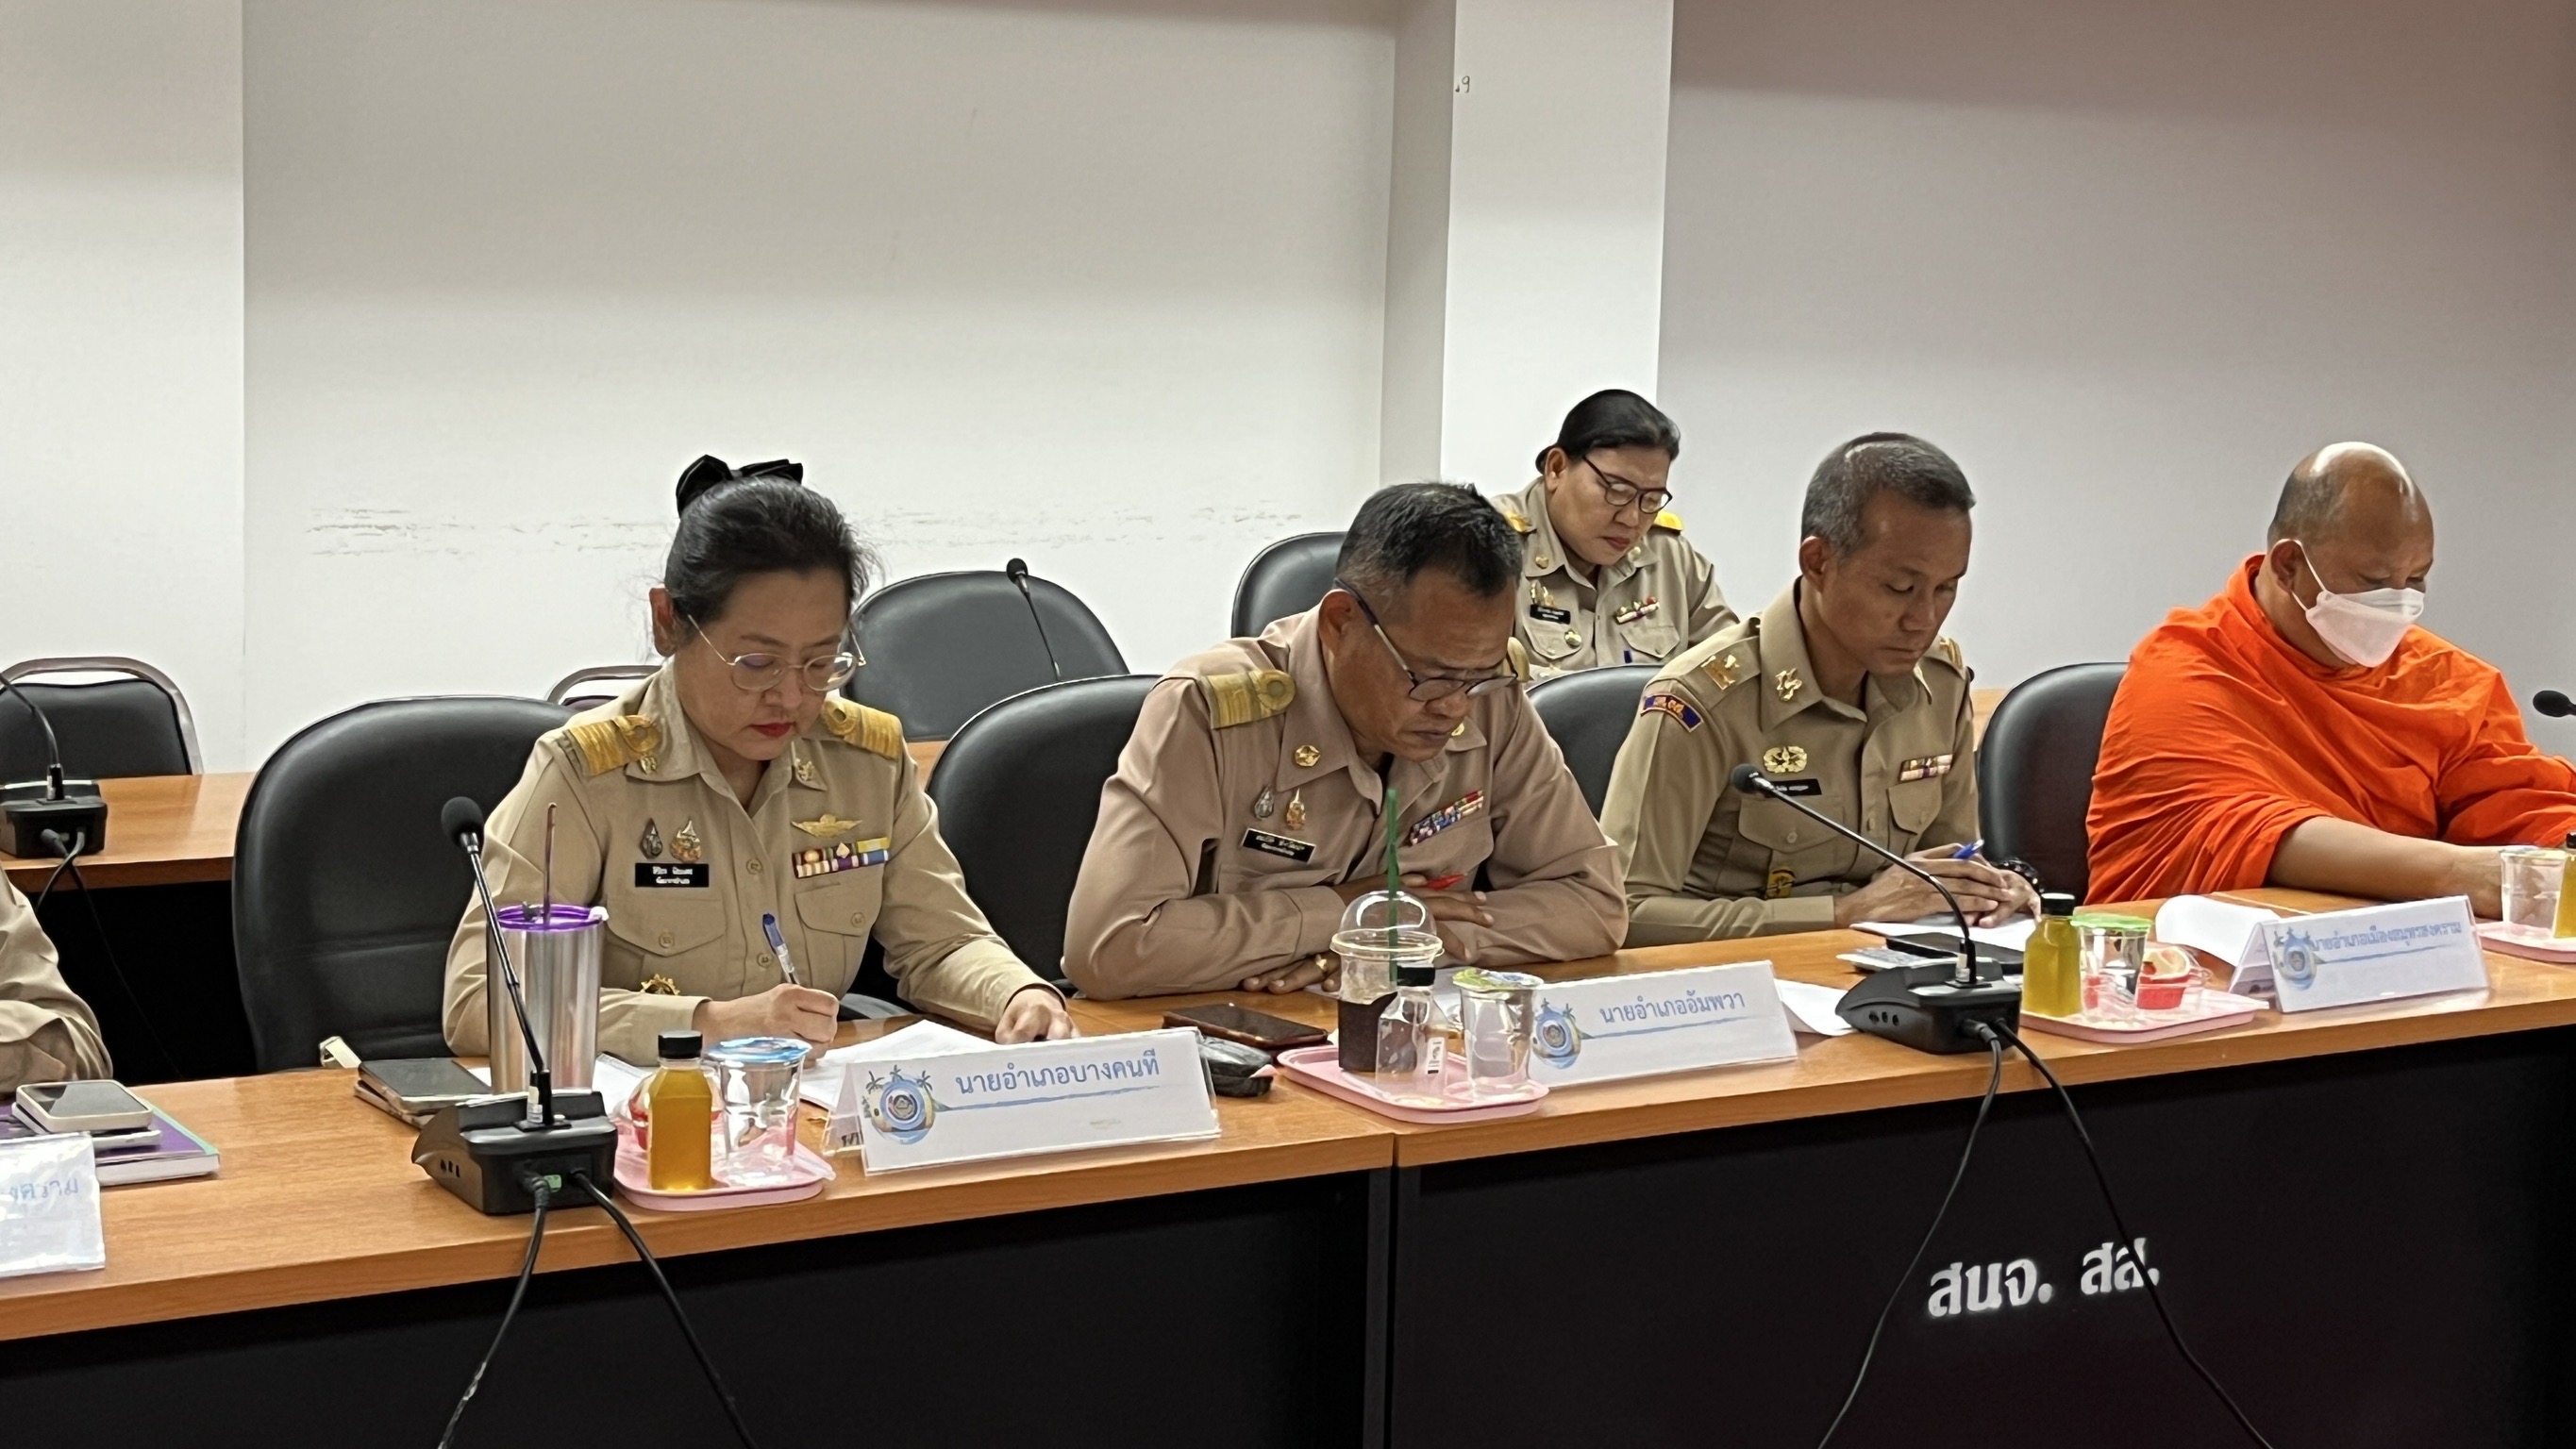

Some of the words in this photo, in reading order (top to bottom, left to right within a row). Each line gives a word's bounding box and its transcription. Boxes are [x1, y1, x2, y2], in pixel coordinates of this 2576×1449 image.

[1599, 990, 1746, 1024] นายอำเภออัมพวา
[955, 1048, 1161, 1094] นายอำเภอบางคนที
[1928, 1257, 2052, 1318] สนจ.
